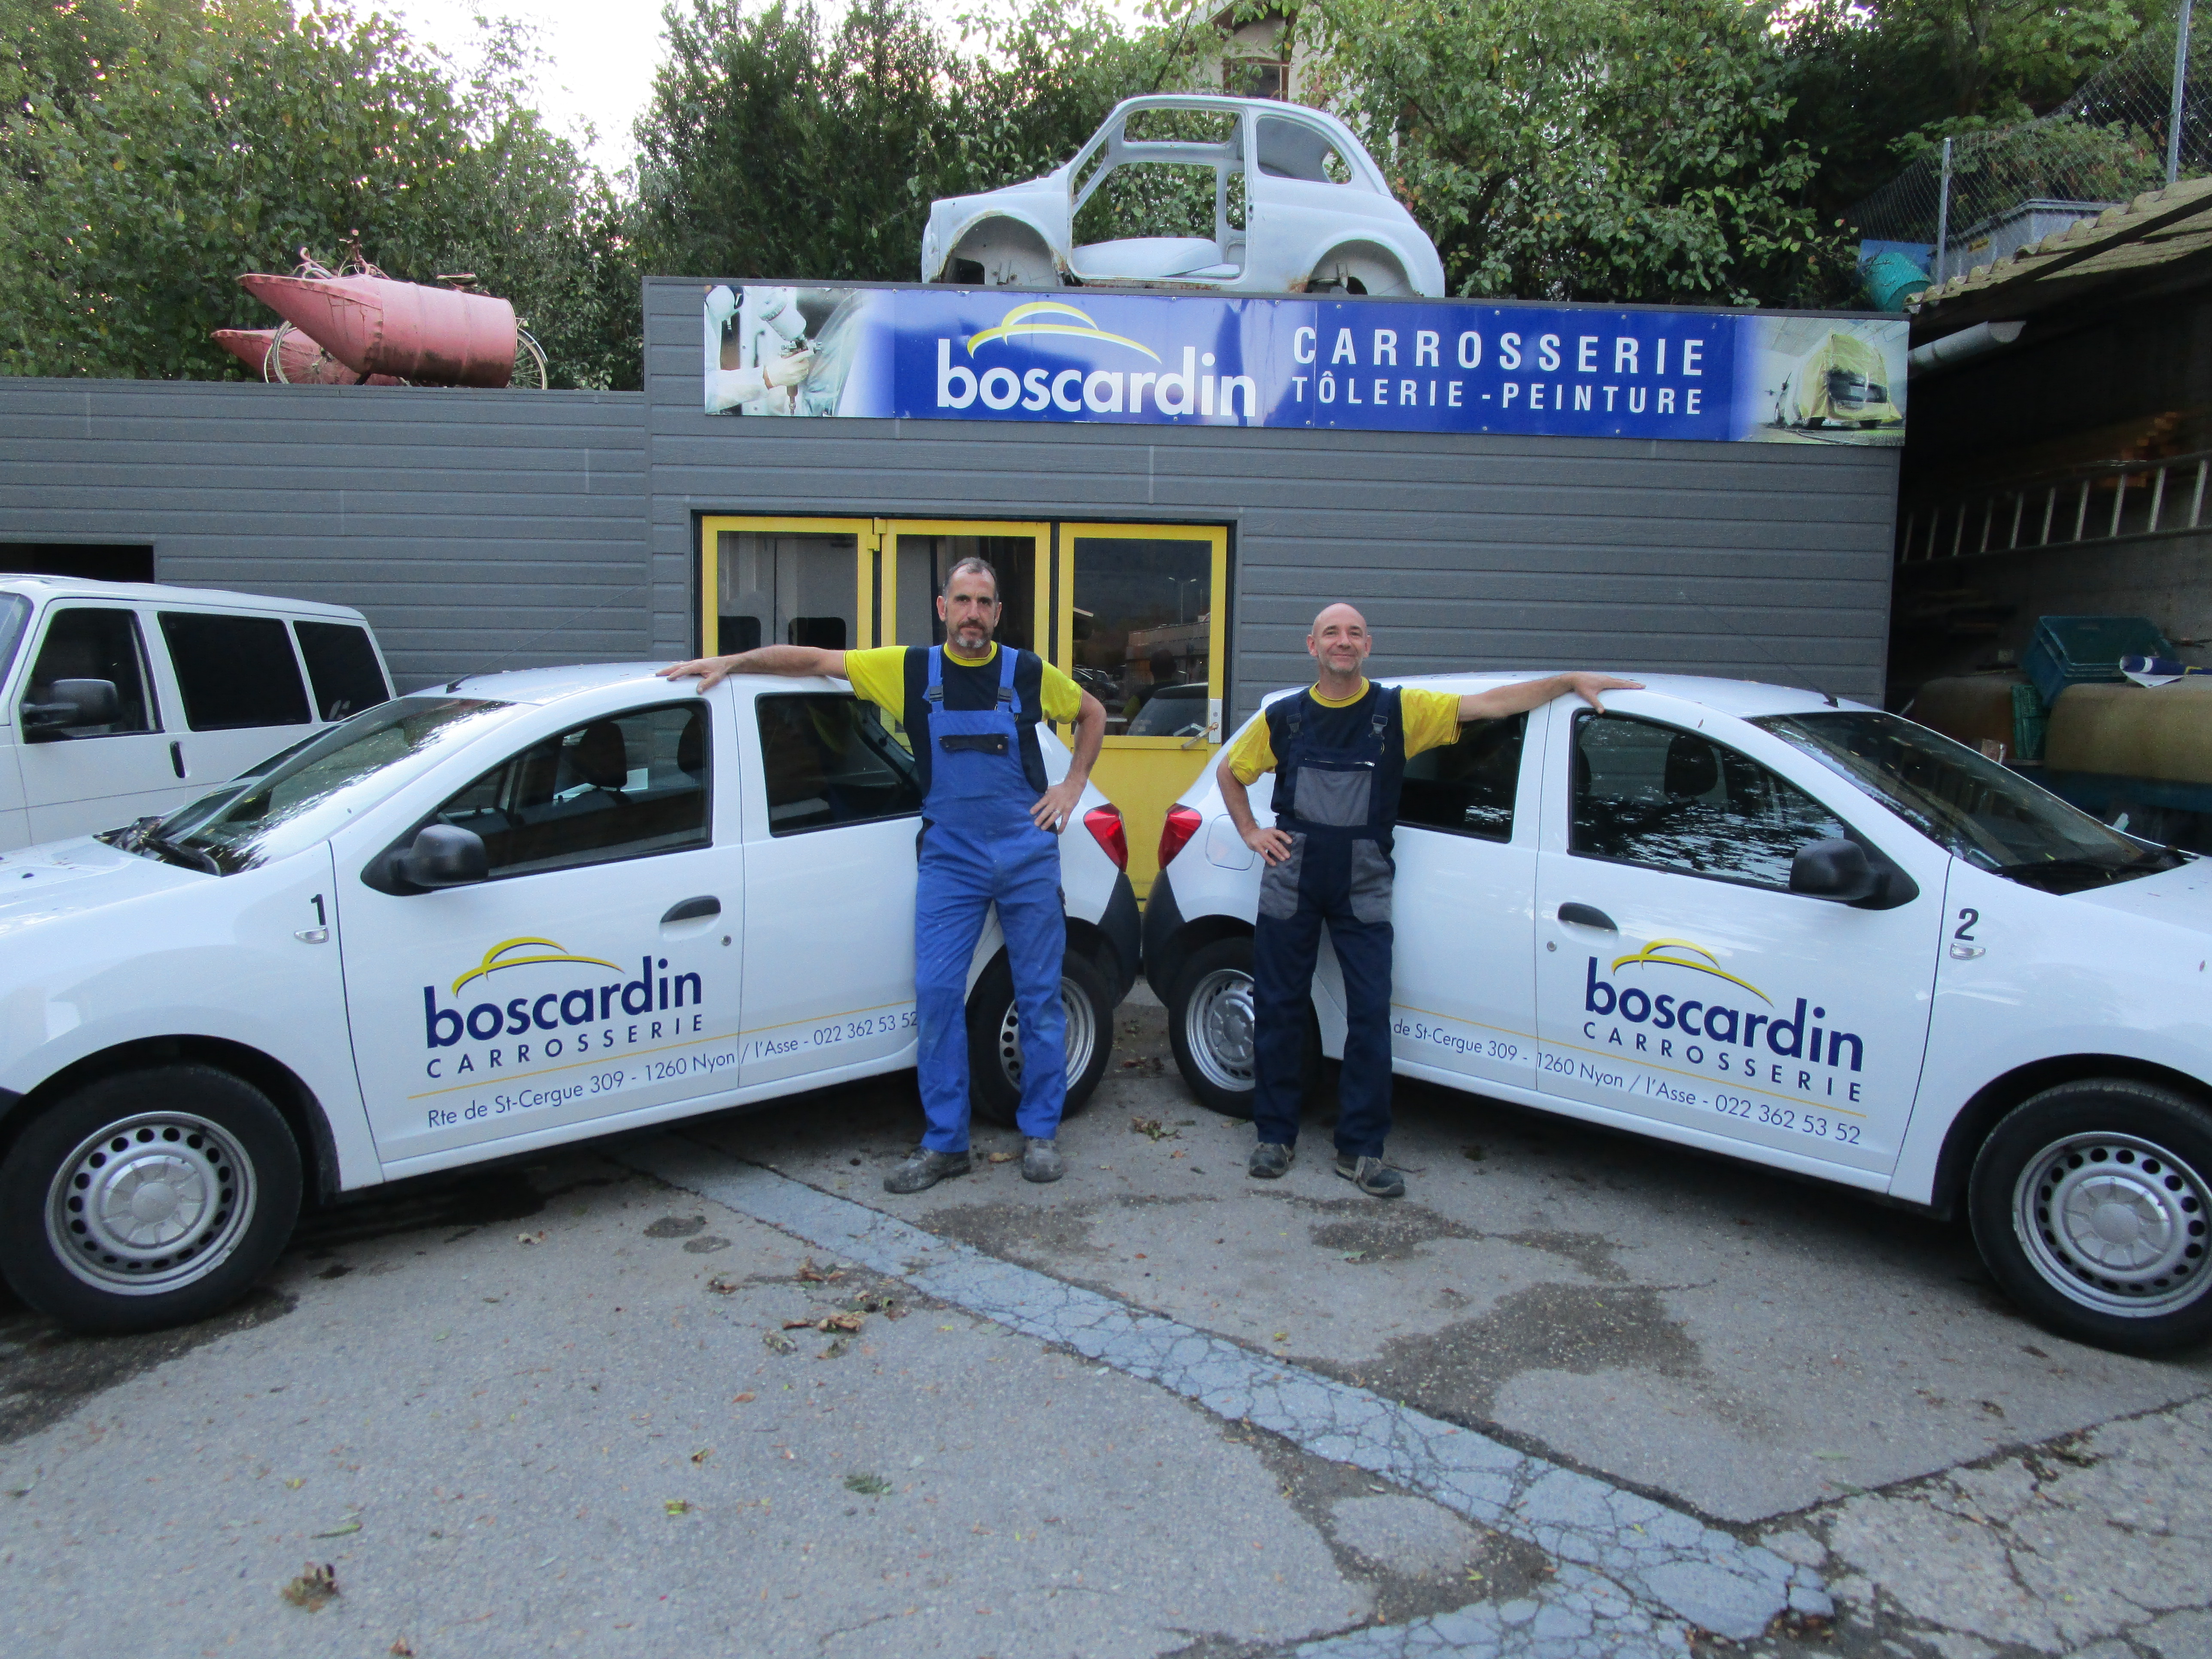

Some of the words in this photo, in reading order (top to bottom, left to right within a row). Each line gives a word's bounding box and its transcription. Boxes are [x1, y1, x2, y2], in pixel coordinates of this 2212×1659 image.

[937, 338, 1256, 418] boscardin
[1293, 327, 1704, 376] CARROSSERIE
[310, 894, 327, 926] 1
[1954, 908, 1979, 941] 2
[424, 955, 702, 1049] boscardin
[1586, 957, 1864, 1072] boscardin
[426, 1014, 702, 1079] CARROSSERIE
[428, 1109, 457, 1128] Rte
[464, 1100, 488, 1119] de
[495, 1085, 584, 1114] St-Cergue
[590, 1070, 624, 1094] 309
[645, 1057, 687, 1081] 1260
[692, 1051, 735, 1073] Nyon
[813, 1027, 842, 1046] 022
[847, 1019, 873, 1039] 362
[878, 1015, 896, 1032] 53
[1393, 1018, 1410, 1036] de
[1415, 1023, 1483, 1054] St-Cergue
[1487, 1040, 1518, 1059] 309
[1536, 1052, 1574, 1076] 1260
[1580, 1062, 1623, 1088] Nyon
[1715, 1094, 1751, 1119] 022
[1758, 1104, 1795, 1130] 362
[1802, 1114, 1827, 1136] 53
[1835, 1122, 1861, 1146] 52
[1583, 1021, 1861, 1103] CARROSSERIE
